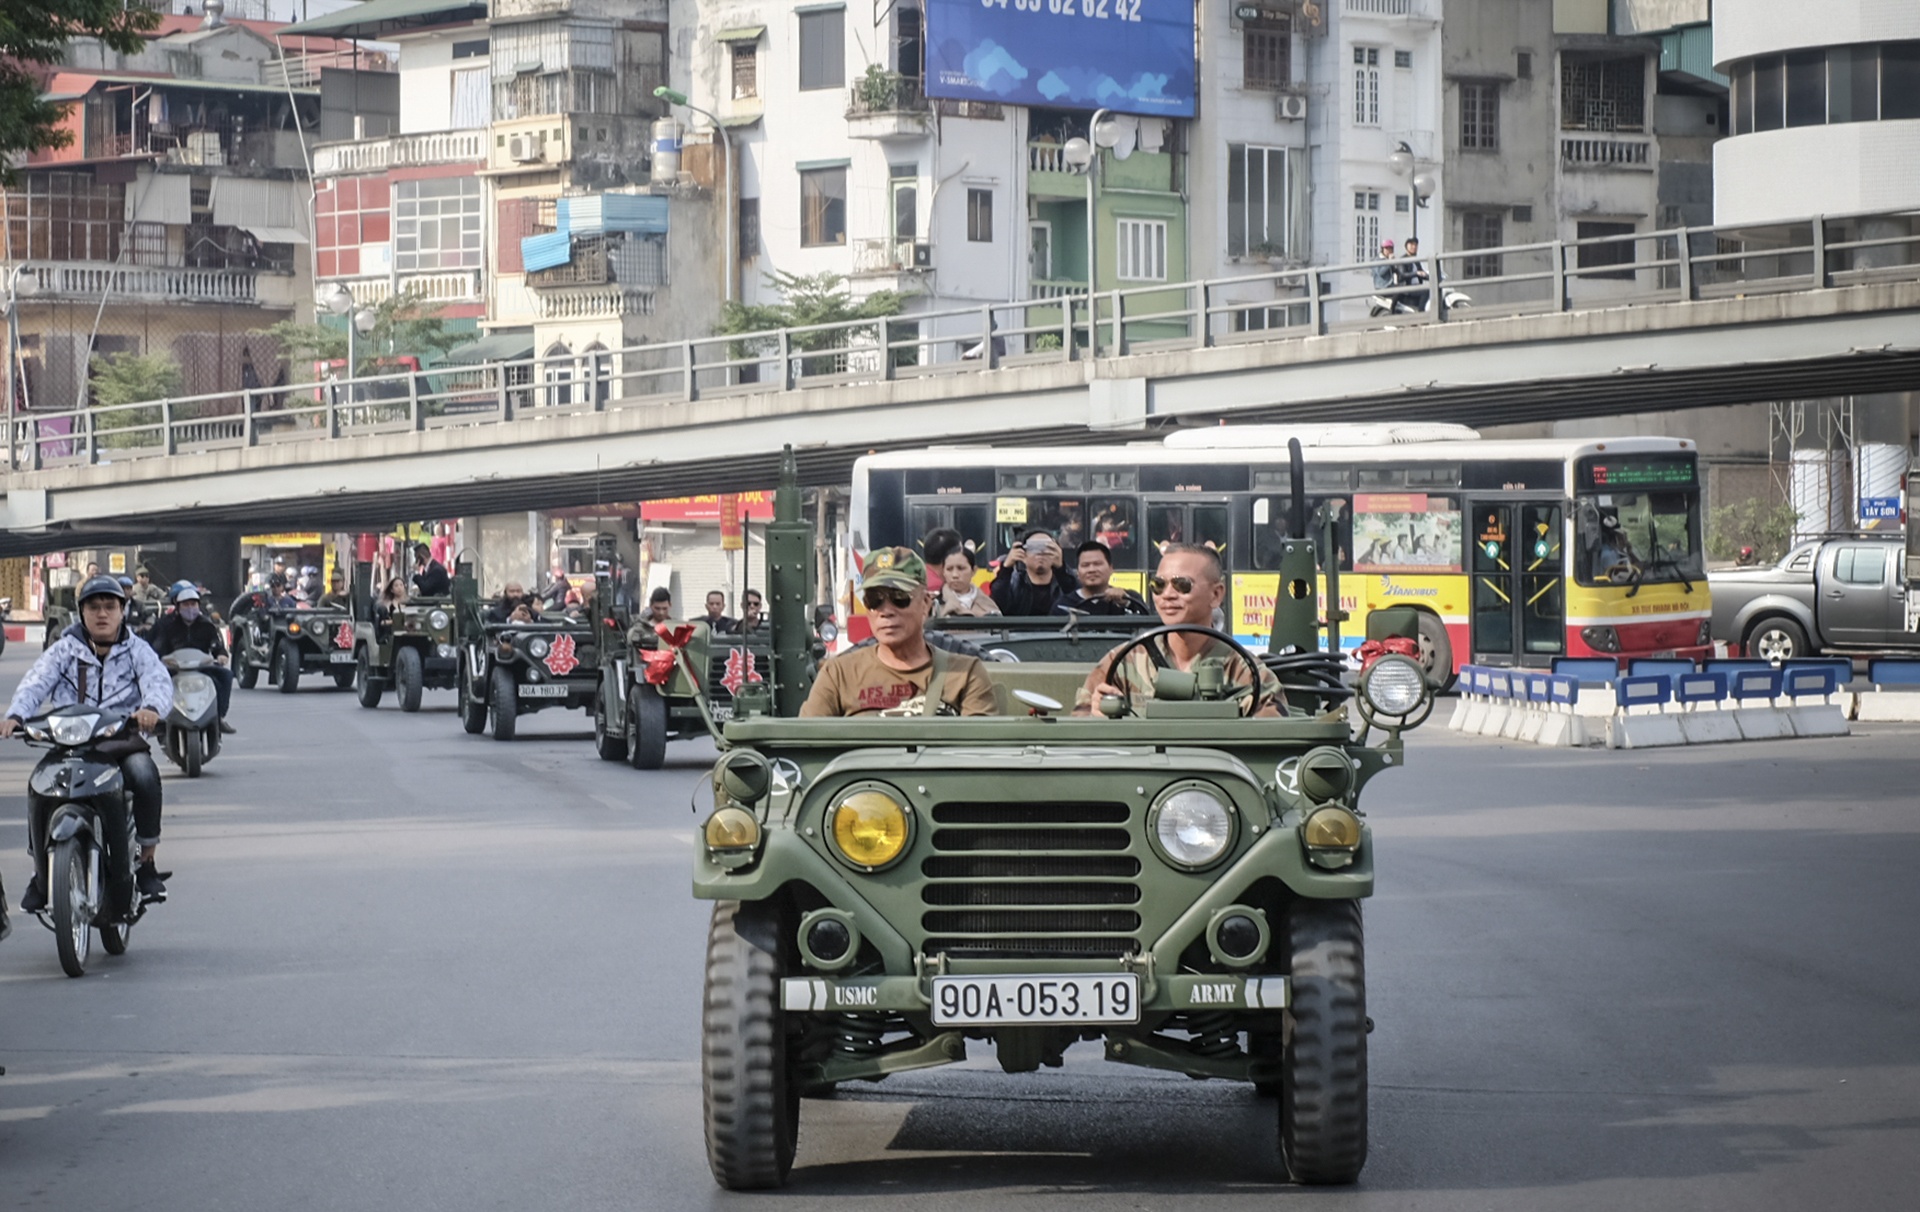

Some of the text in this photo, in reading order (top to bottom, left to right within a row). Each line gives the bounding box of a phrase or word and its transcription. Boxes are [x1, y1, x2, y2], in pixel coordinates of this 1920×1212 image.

[1115, 0, 1141, 22] 42
[858, 686, 883, 700] AFS
[834, 986, 877, 1006] USMC
[940, 981, 1132, 1018] 90A-053.19
[1190, 984, 1236, 1004] ARMY
